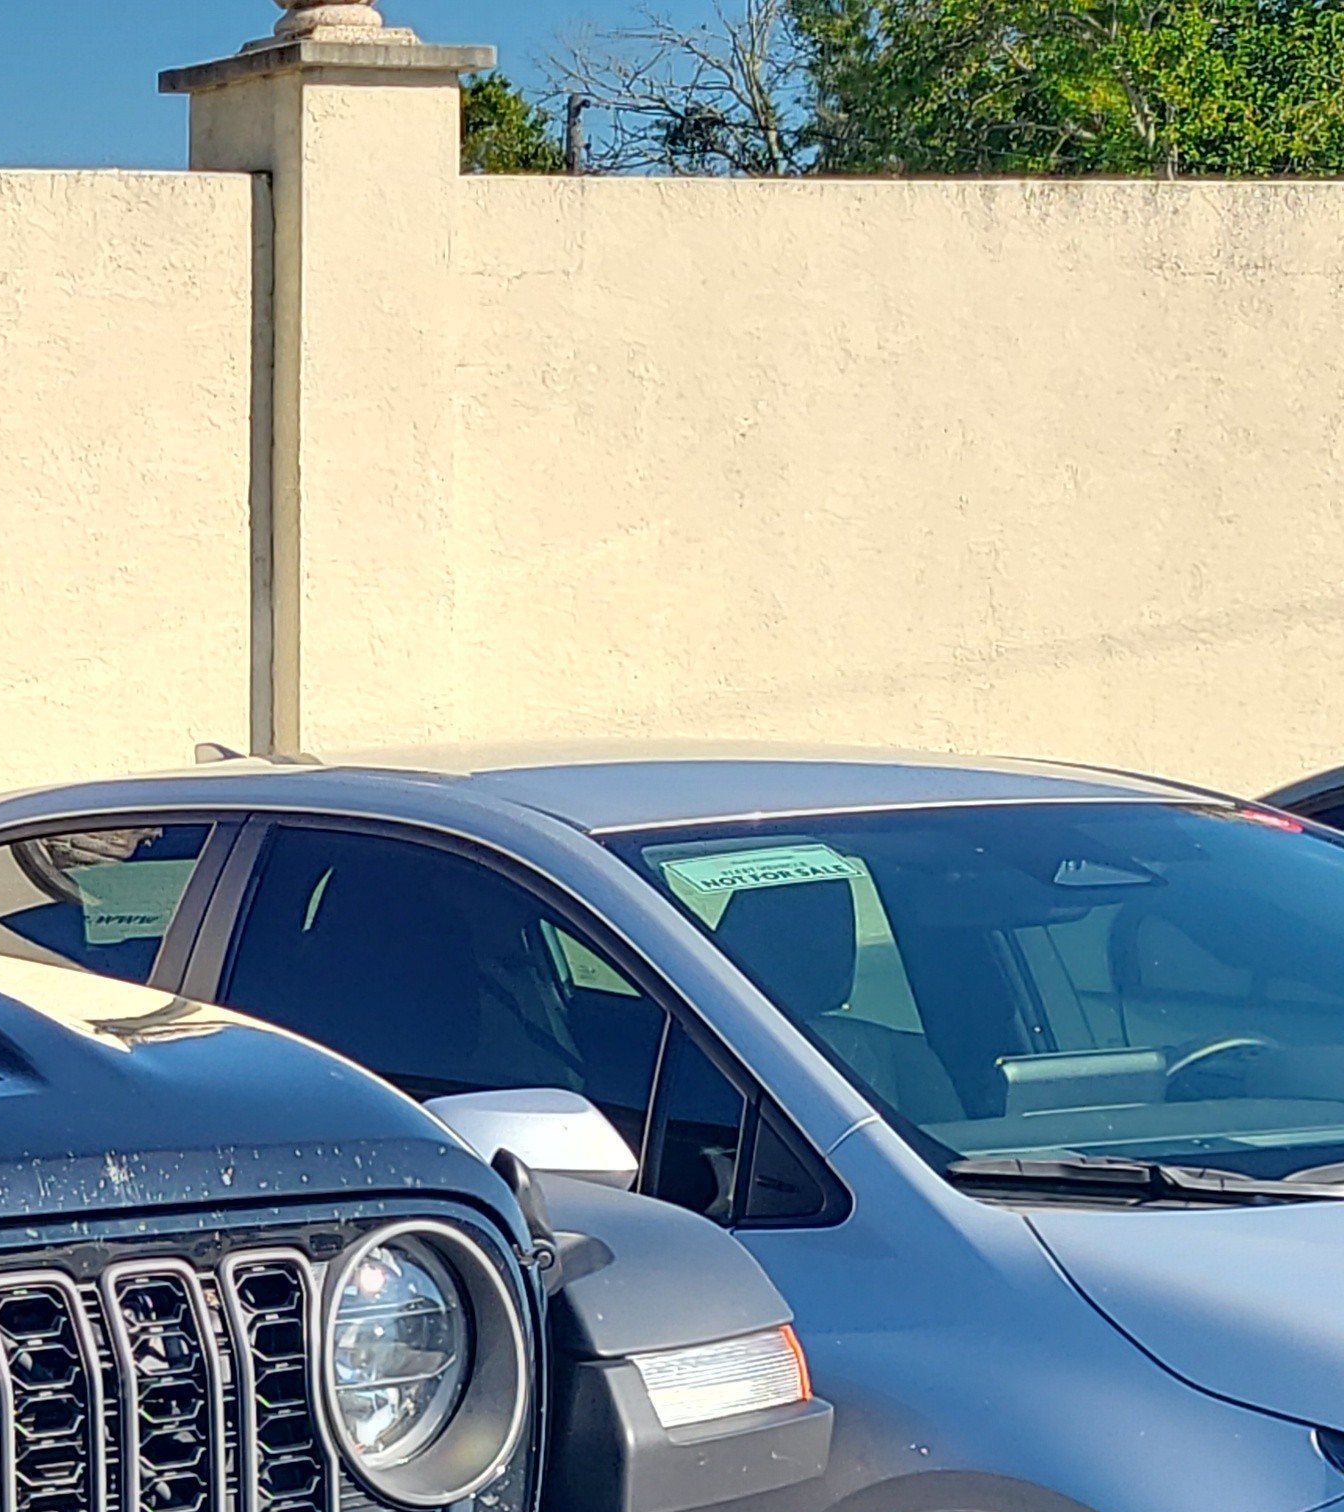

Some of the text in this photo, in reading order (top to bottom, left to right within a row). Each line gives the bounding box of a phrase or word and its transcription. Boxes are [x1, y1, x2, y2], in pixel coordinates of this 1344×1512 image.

[700, 864, 851, 889] NOT FOR SALE
